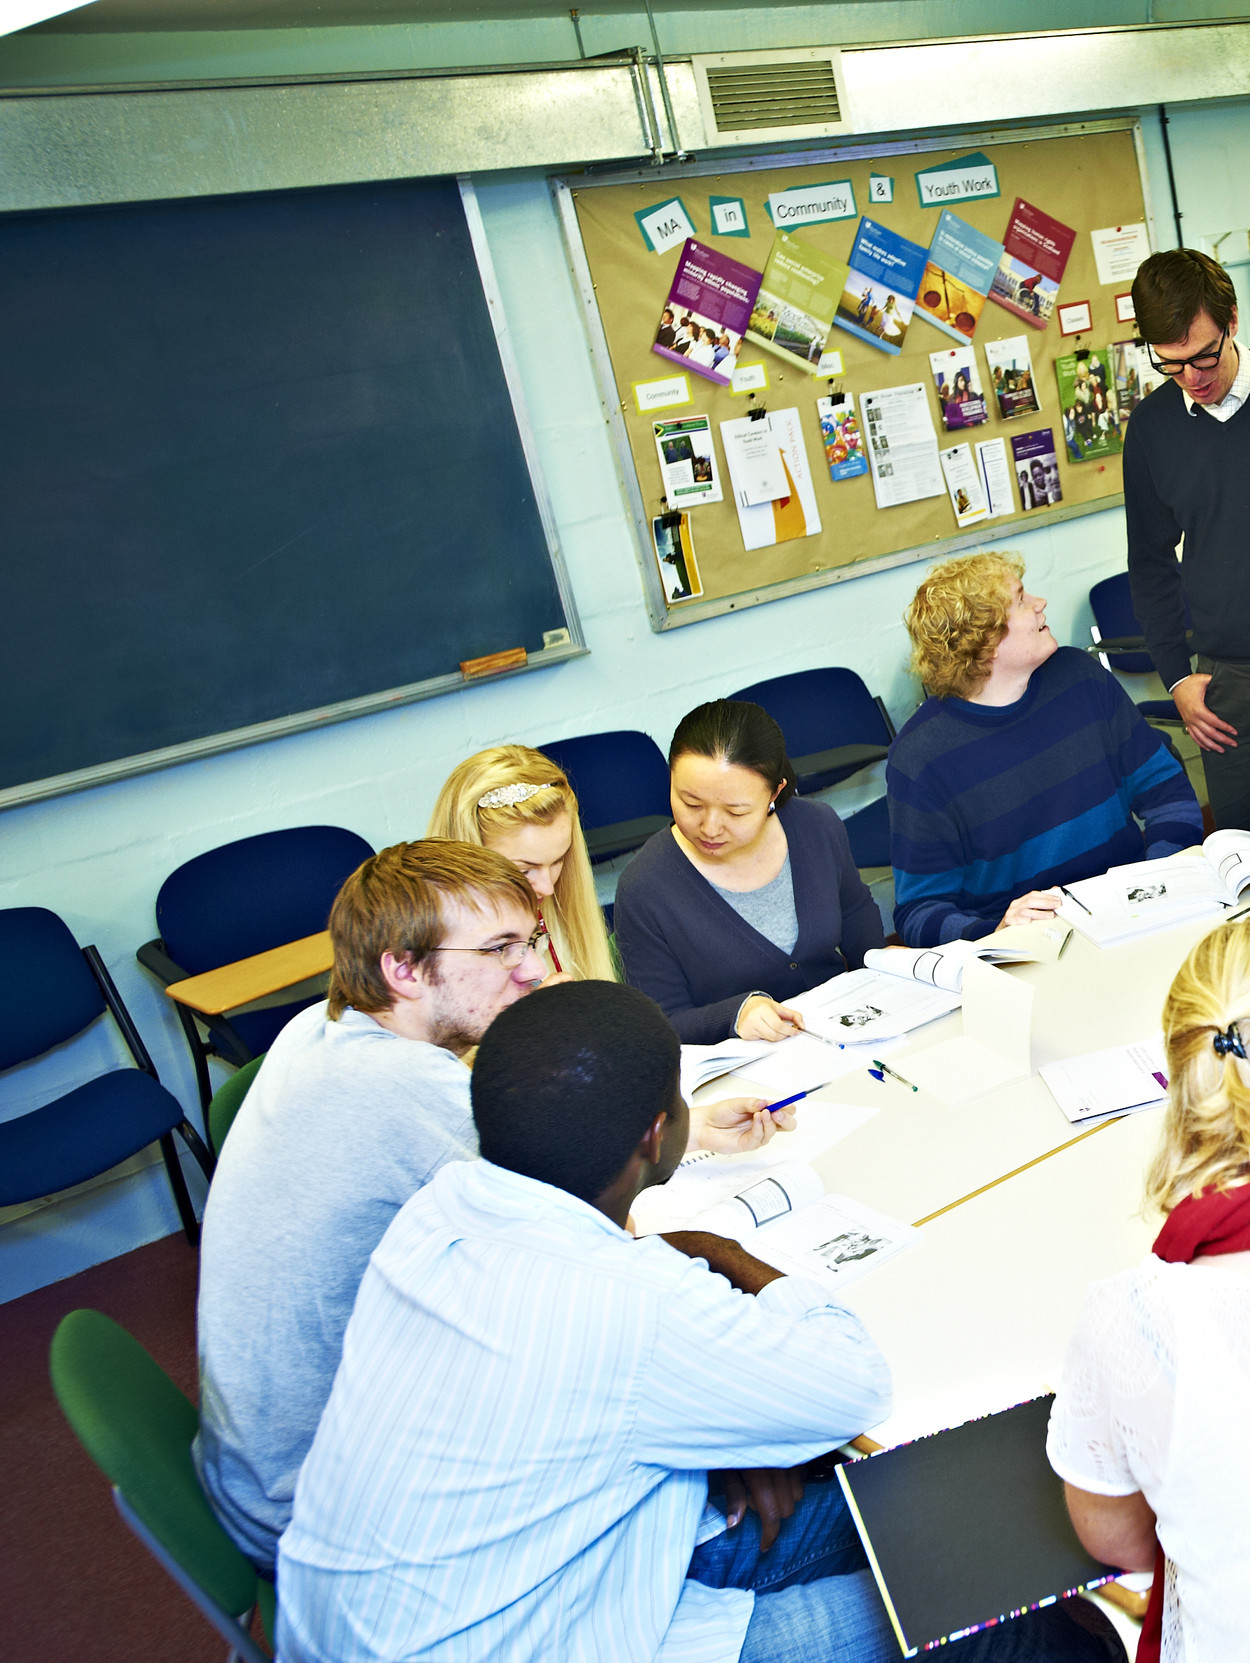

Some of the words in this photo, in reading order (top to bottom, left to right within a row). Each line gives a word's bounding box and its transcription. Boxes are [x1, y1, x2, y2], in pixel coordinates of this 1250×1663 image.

[656, 218, 682, 240] MA
[723, 208, 738, 223] in
[776, 196, 848, 220] Community
[876, 182, 886, 197] &
[925, 183, 960, 198] Youth
[961, 177, 993, 193] Work
